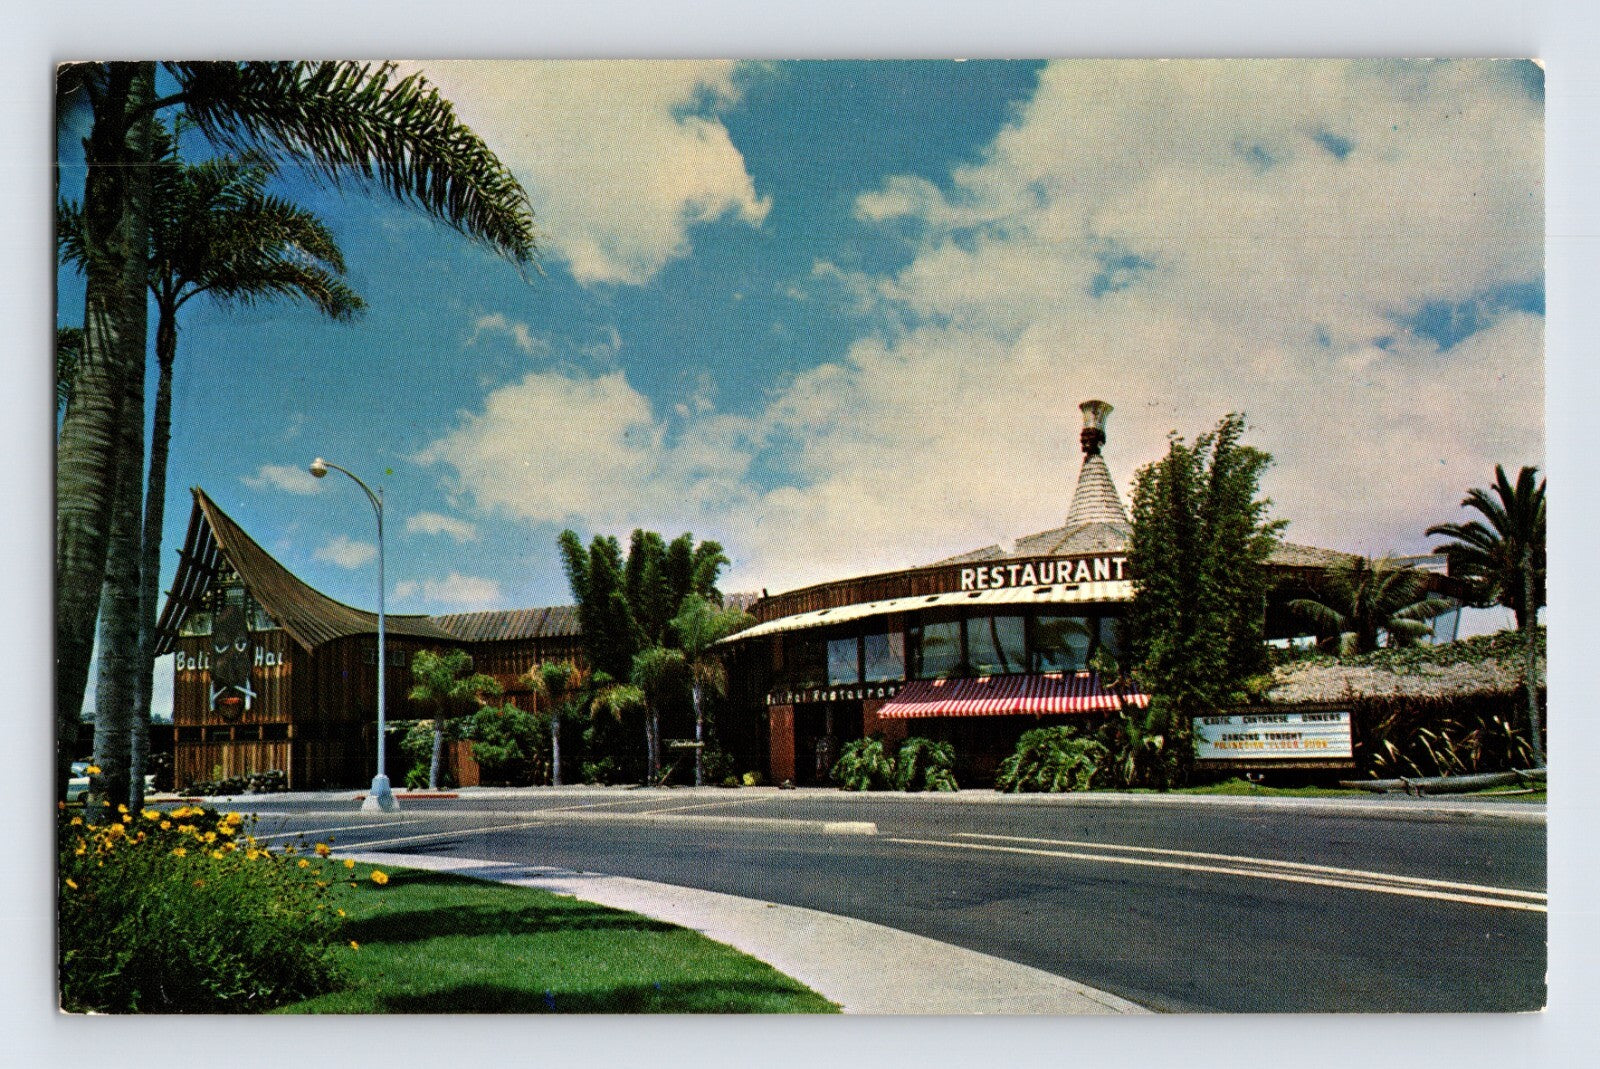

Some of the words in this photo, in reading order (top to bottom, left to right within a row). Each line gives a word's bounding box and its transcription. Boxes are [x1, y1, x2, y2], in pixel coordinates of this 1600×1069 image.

[961, 557, 1127, 590] RESTAURANT
[177, 650, 210, 671] Bali
[254, 646, 284, 667] Hai
[813, 686, 903, 702] Restauran
